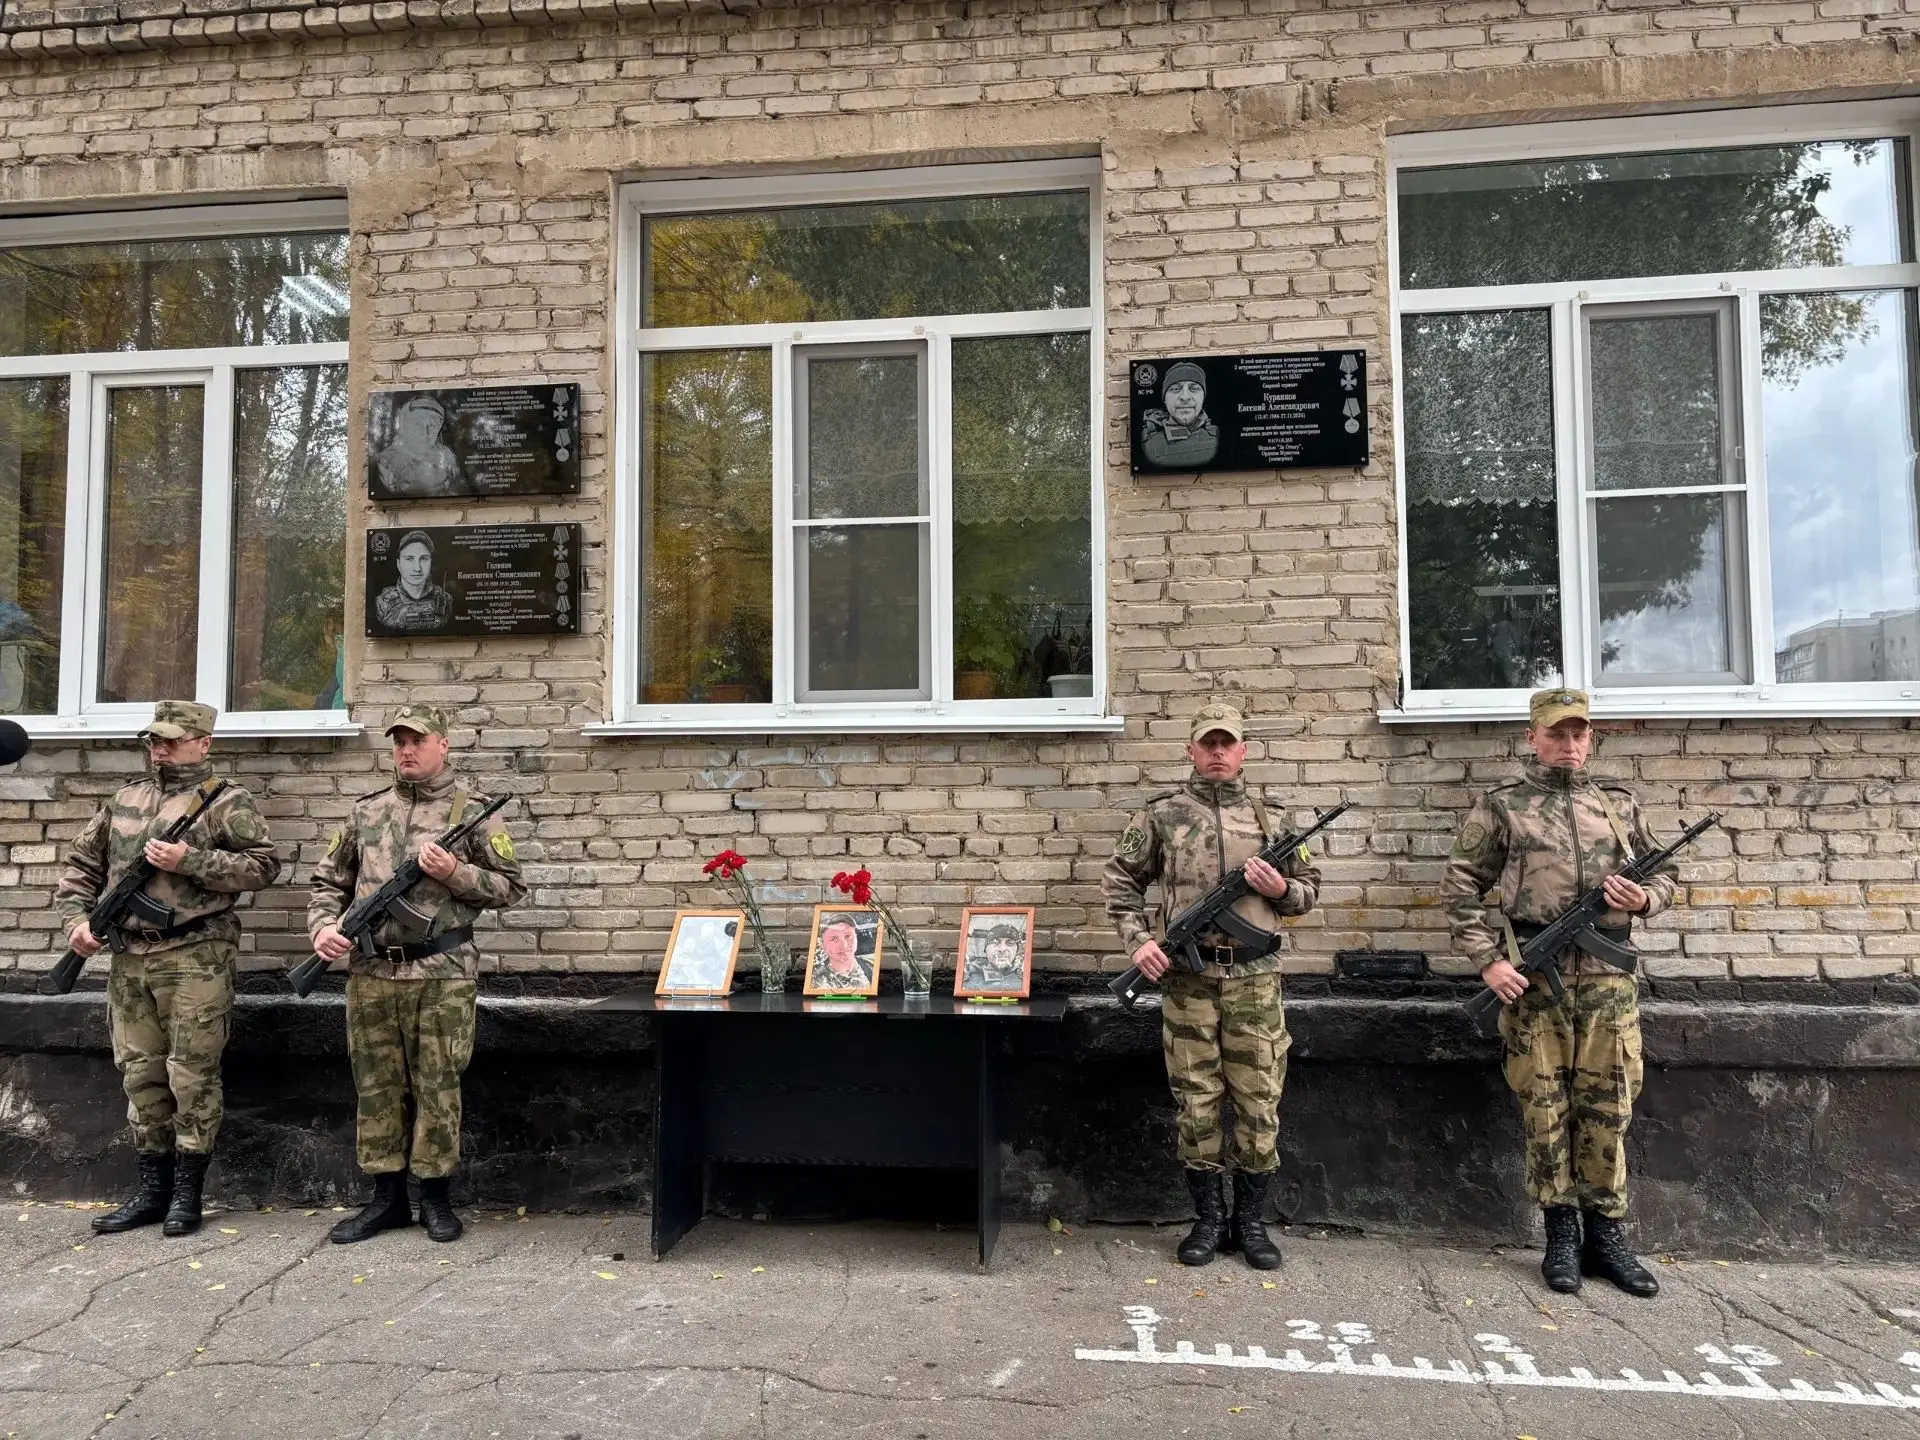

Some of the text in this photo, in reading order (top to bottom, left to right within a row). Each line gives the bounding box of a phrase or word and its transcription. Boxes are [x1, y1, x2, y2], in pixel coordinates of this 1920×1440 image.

[1238, 403, 1319, 412] Евгений Александрович
[1122, 1305, 1161, 1325] 3
[1473, 1332, 1524, 1353] 2
